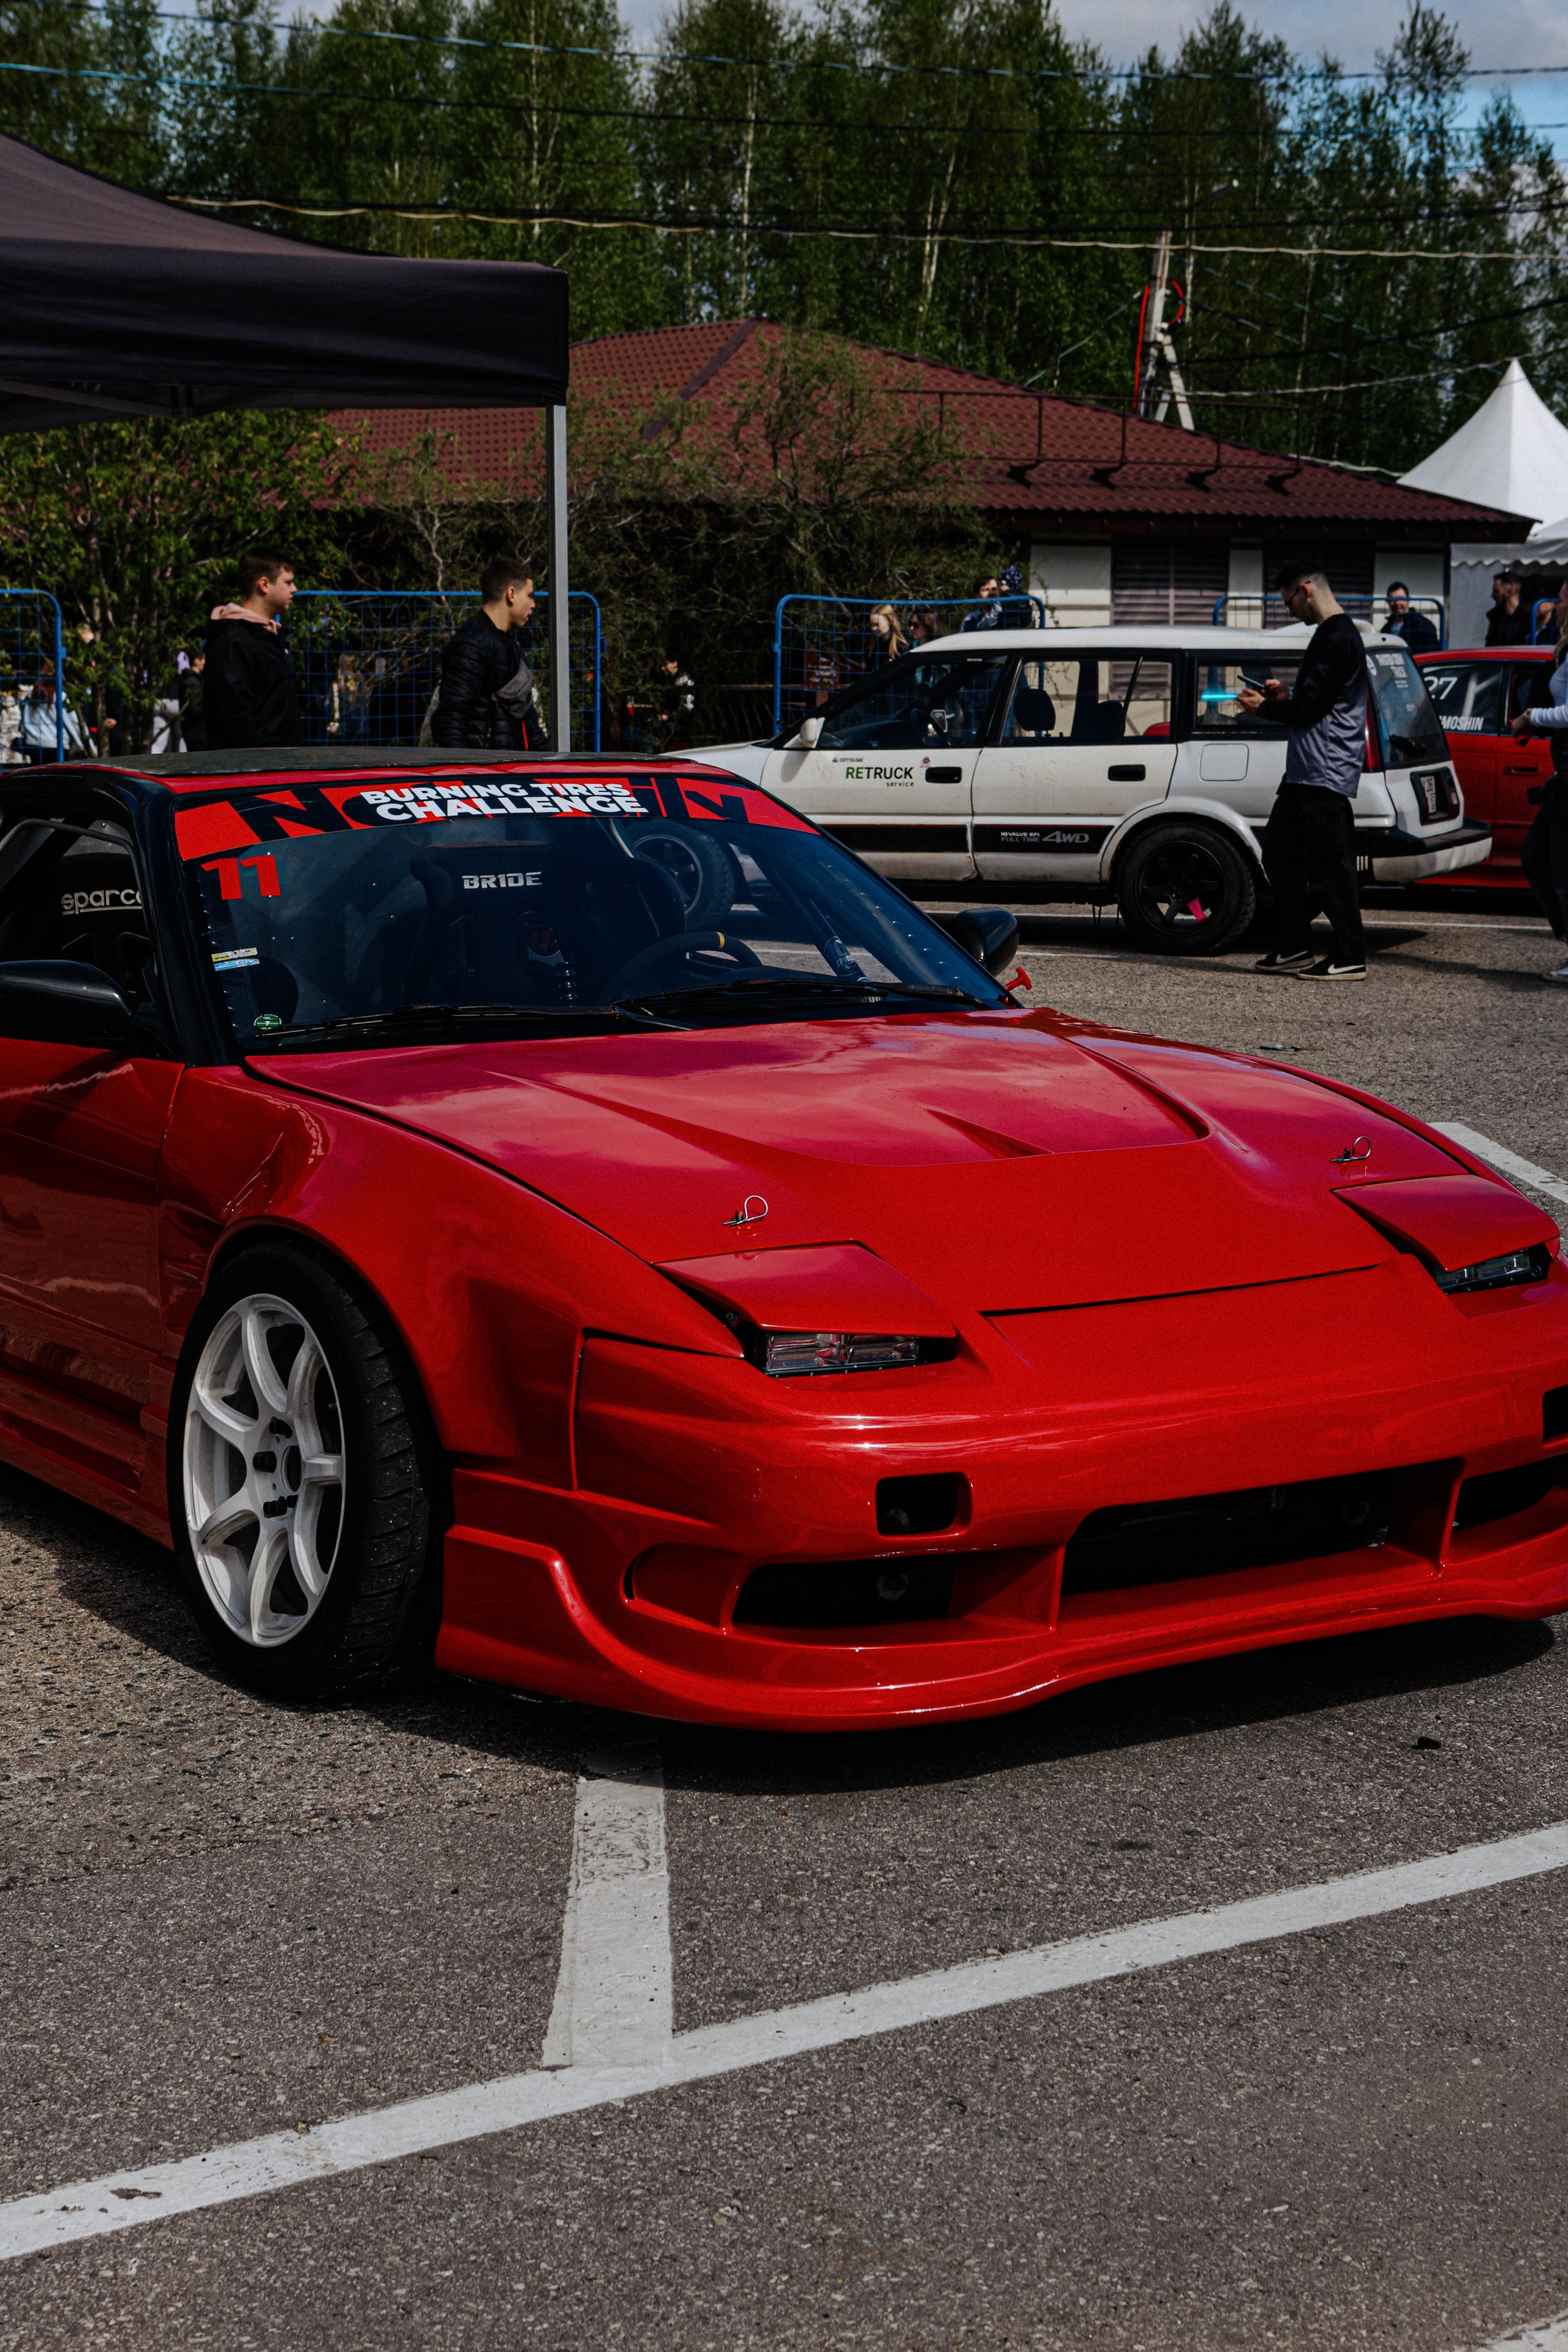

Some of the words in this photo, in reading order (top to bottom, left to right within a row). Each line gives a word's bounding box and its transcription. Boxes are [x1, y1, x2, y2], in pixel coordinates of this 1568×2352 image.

[1439, 715, 1484, 731] MOSHIN
[846, 767, 913, 779] RETRUCK
[360, 783, 529, 804] BURNING
[530, 783, 630, 796] TIRES
[376, 796, 649, 821] CHALLENGE
[1042, 831, 1090, 843] 4WD
[201, 855, 281, 900] 11
[462, 871, 542, 889] BRIDE
